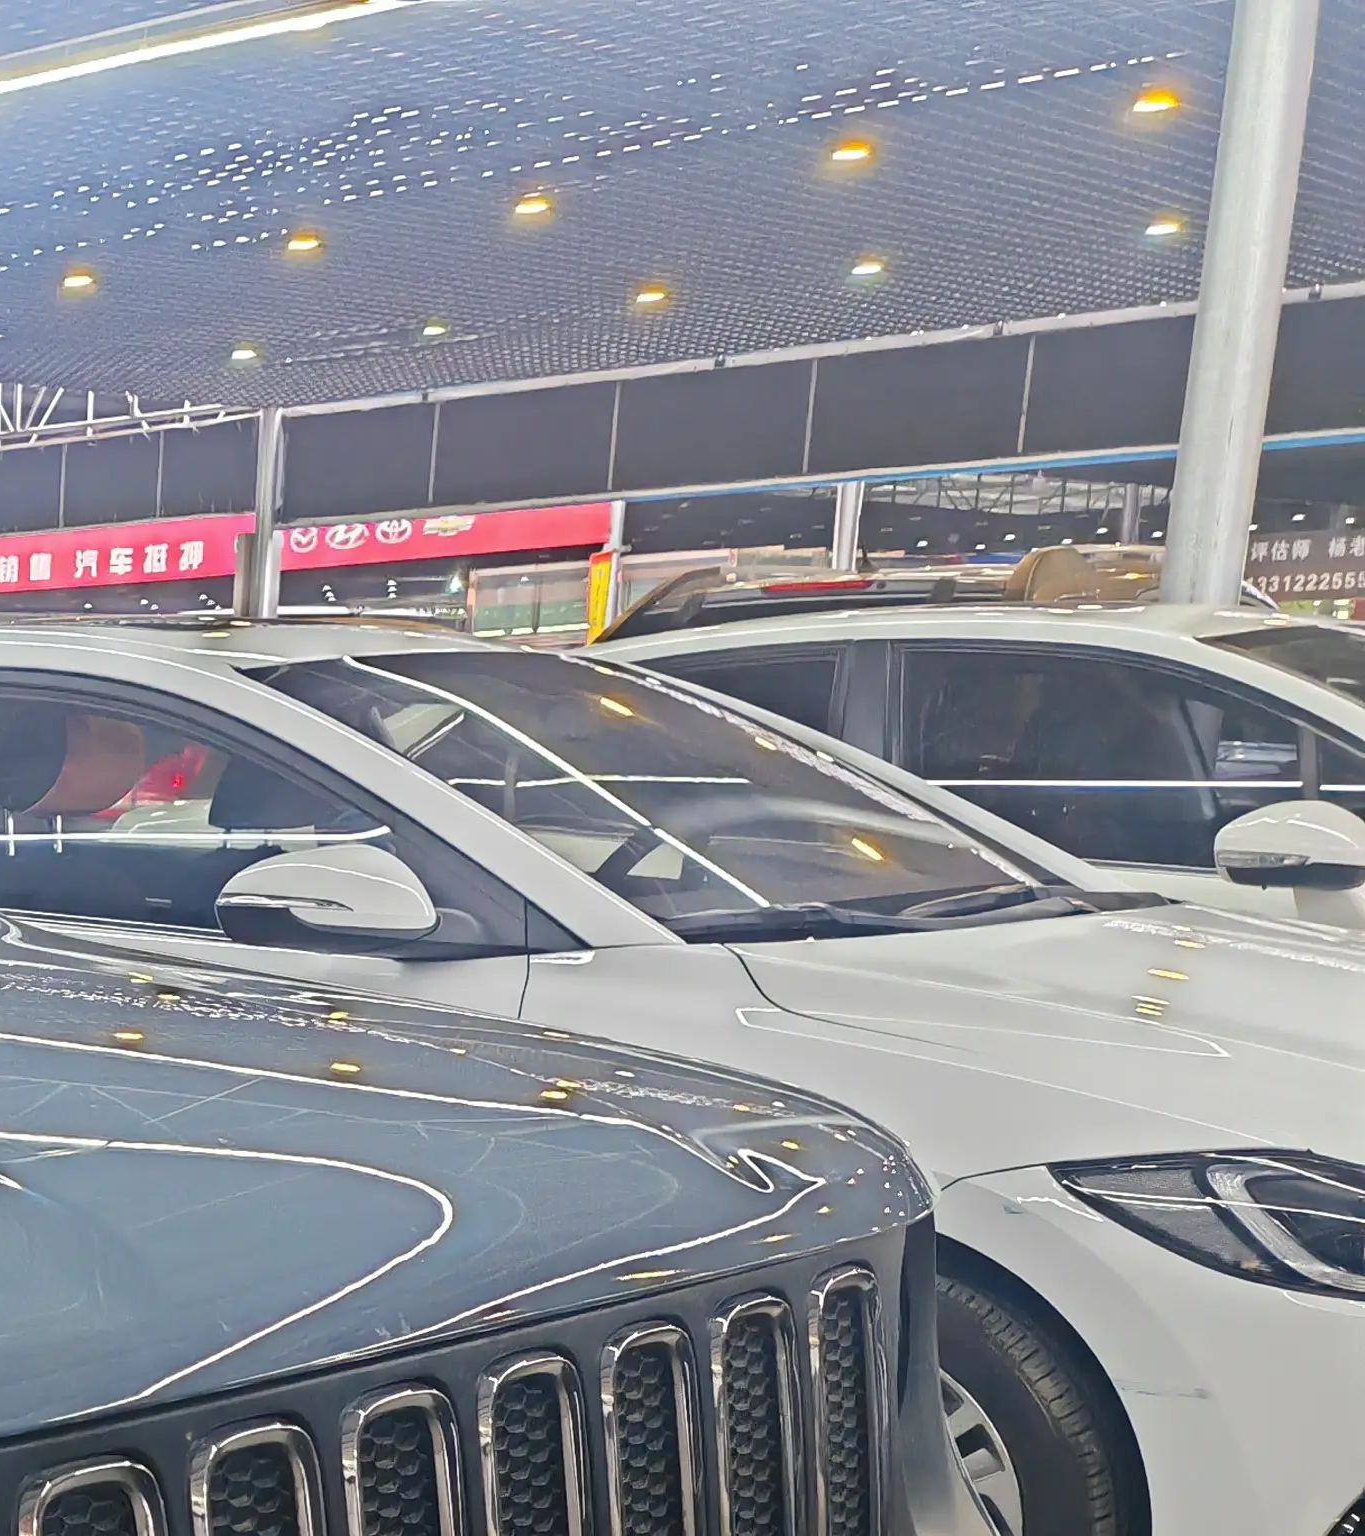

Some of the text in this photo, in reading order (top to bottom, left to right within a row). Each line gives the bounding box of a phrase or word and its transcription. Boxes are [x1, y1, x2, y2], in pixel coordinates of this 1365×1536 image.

[74, 541, 204, 579] 汽车抵押
[1251, 539, 1312, 562] 评估师
